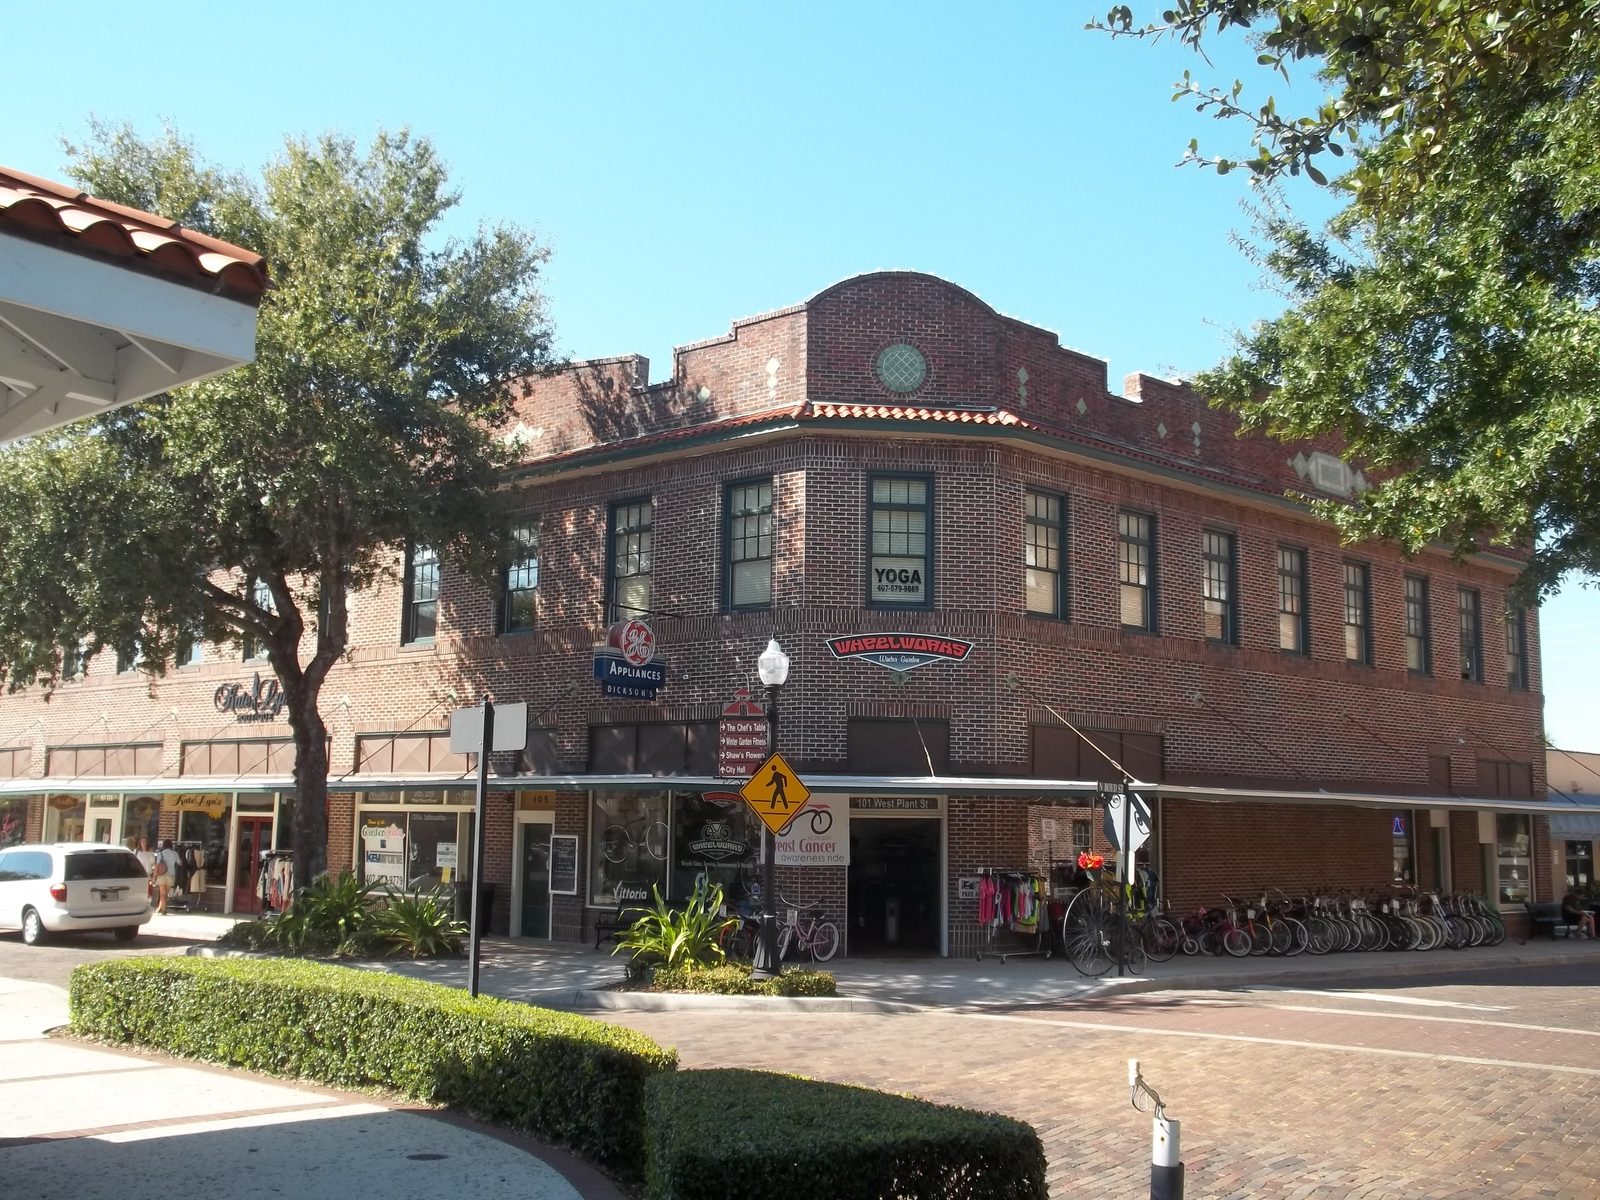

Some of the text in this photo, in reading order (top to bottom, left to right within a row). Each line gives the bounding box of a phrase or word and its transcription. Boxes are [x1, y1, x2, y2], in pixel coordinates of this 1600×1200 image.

[874, 568, 921, 584] YOGA
[834, 636, 967, 657] WHEELWORKS
[879, 655, 920, 663] Winter Garden
[609, 660, 661, 680] APPLIANCES
[607, 685, 653, 698] DICKSON'S
[726, 723, 766, 731] The Chef's Table
[726, 737, 767, 746] Winter Garden Fitness
[726, 751, 766, 759] Shaw's Flowers
[726, 765, 746, 774] City Hall
[858, 799, 928, 809] 101 West Plant St
[692, 841, 743, 852] WHEELWORKS
[800, 839, 838, 853] Cancer
[781, 853, 845, 863] awareness ride
[613, 880, 648, 900] Vittoria
